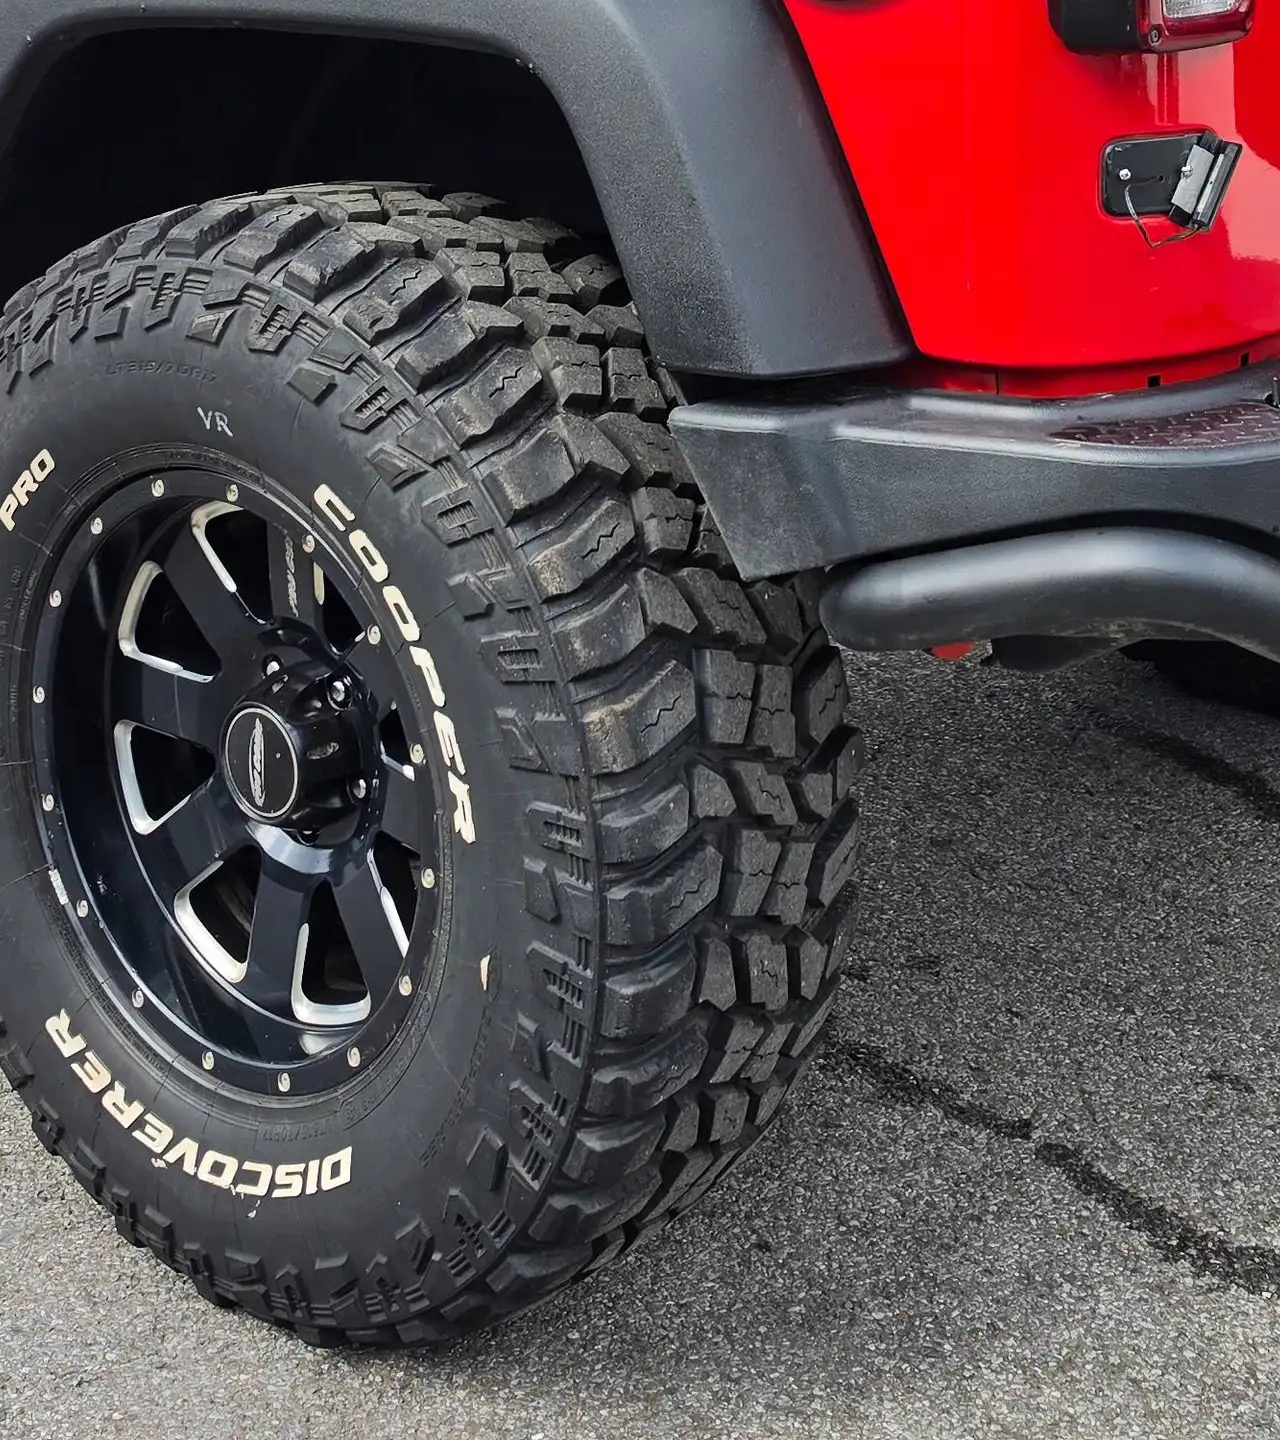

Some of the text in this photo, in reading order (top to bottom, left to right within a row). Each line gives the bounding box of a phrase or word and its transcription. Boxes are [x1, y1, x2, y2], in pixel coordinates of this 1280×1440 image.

[196, 406, 234, 437] VR
[313, 482, 477, 844] COOPER
[45, 1007, 354, 1199] DISCOVERER
